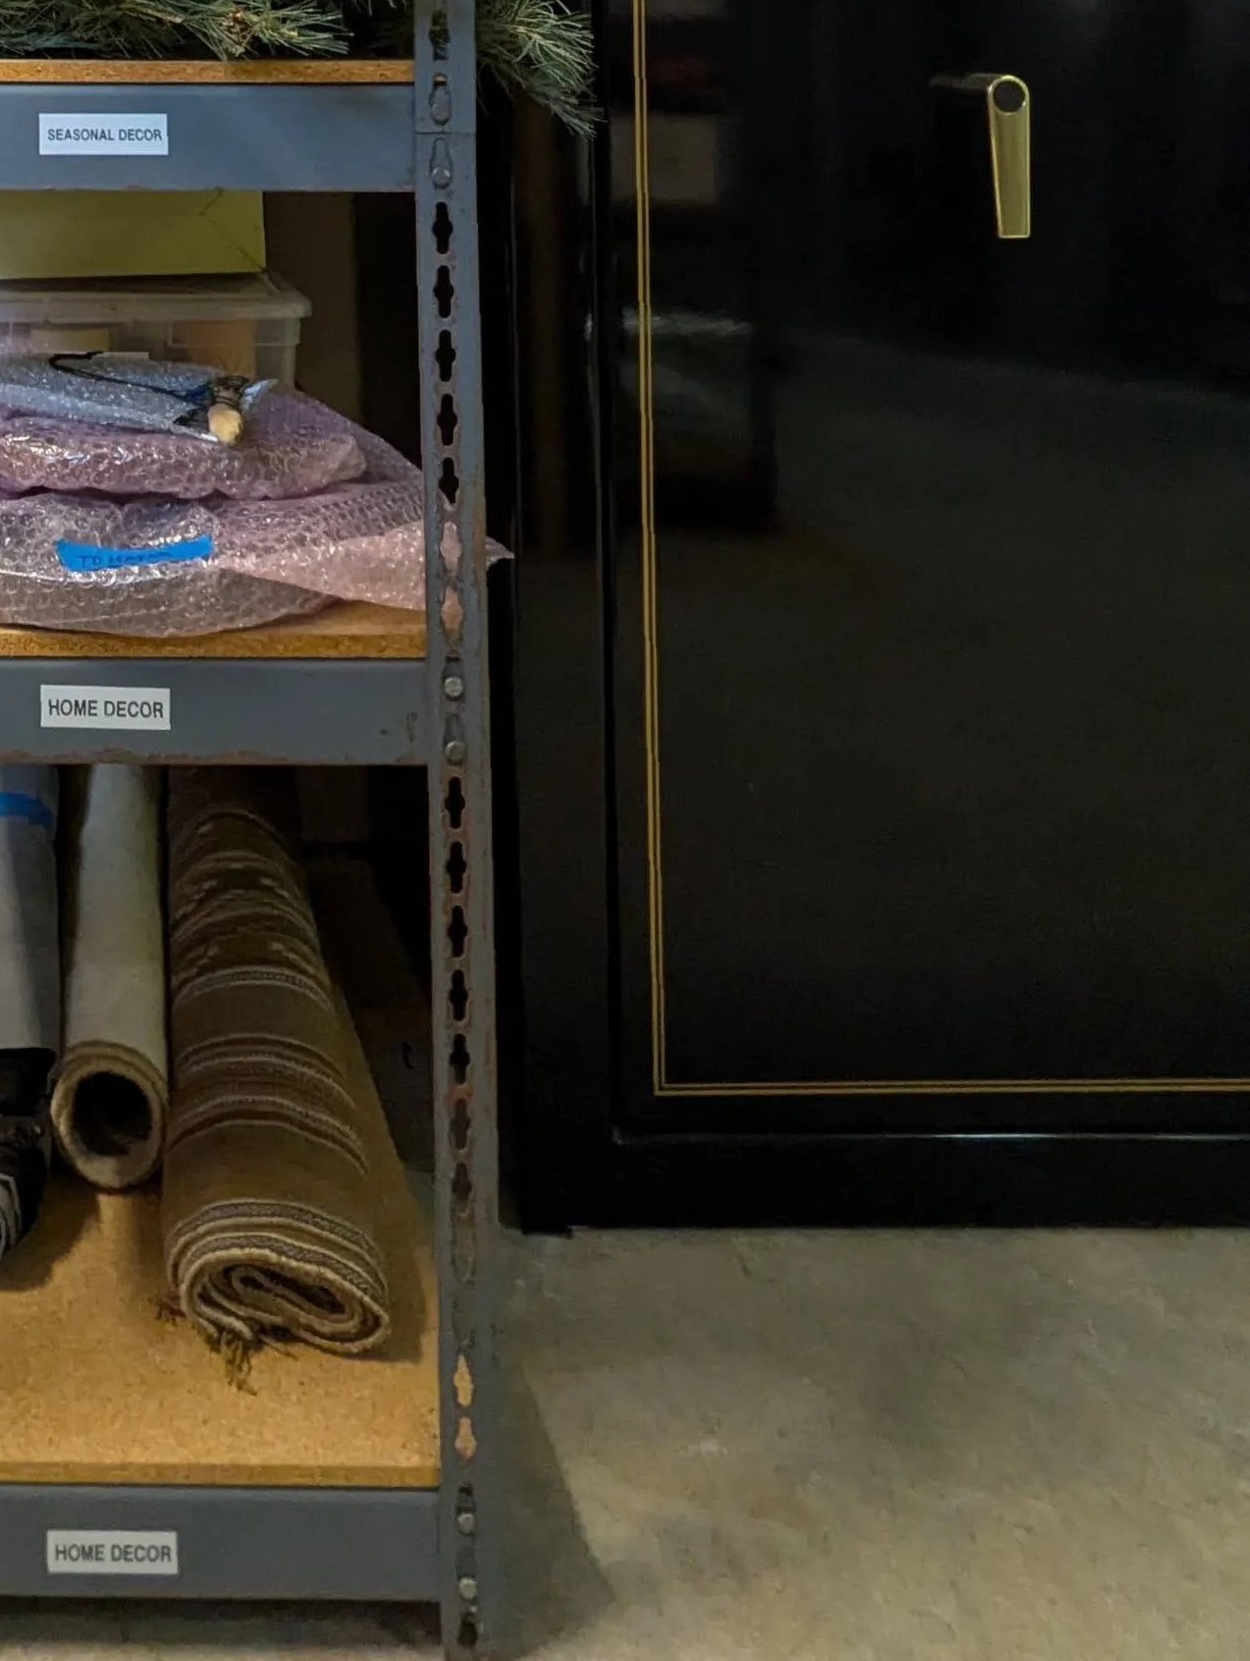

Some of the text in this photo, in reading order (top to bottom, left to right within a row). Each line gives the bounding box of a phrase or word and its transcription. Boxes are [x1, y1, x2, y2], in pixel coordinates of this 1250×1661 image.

[47, 128, 163, 142] SEASONAL DECOR
[48, 698, 164, 719] HOME DECOR
[54, 1543, 172, 1563] HOME DECOR
